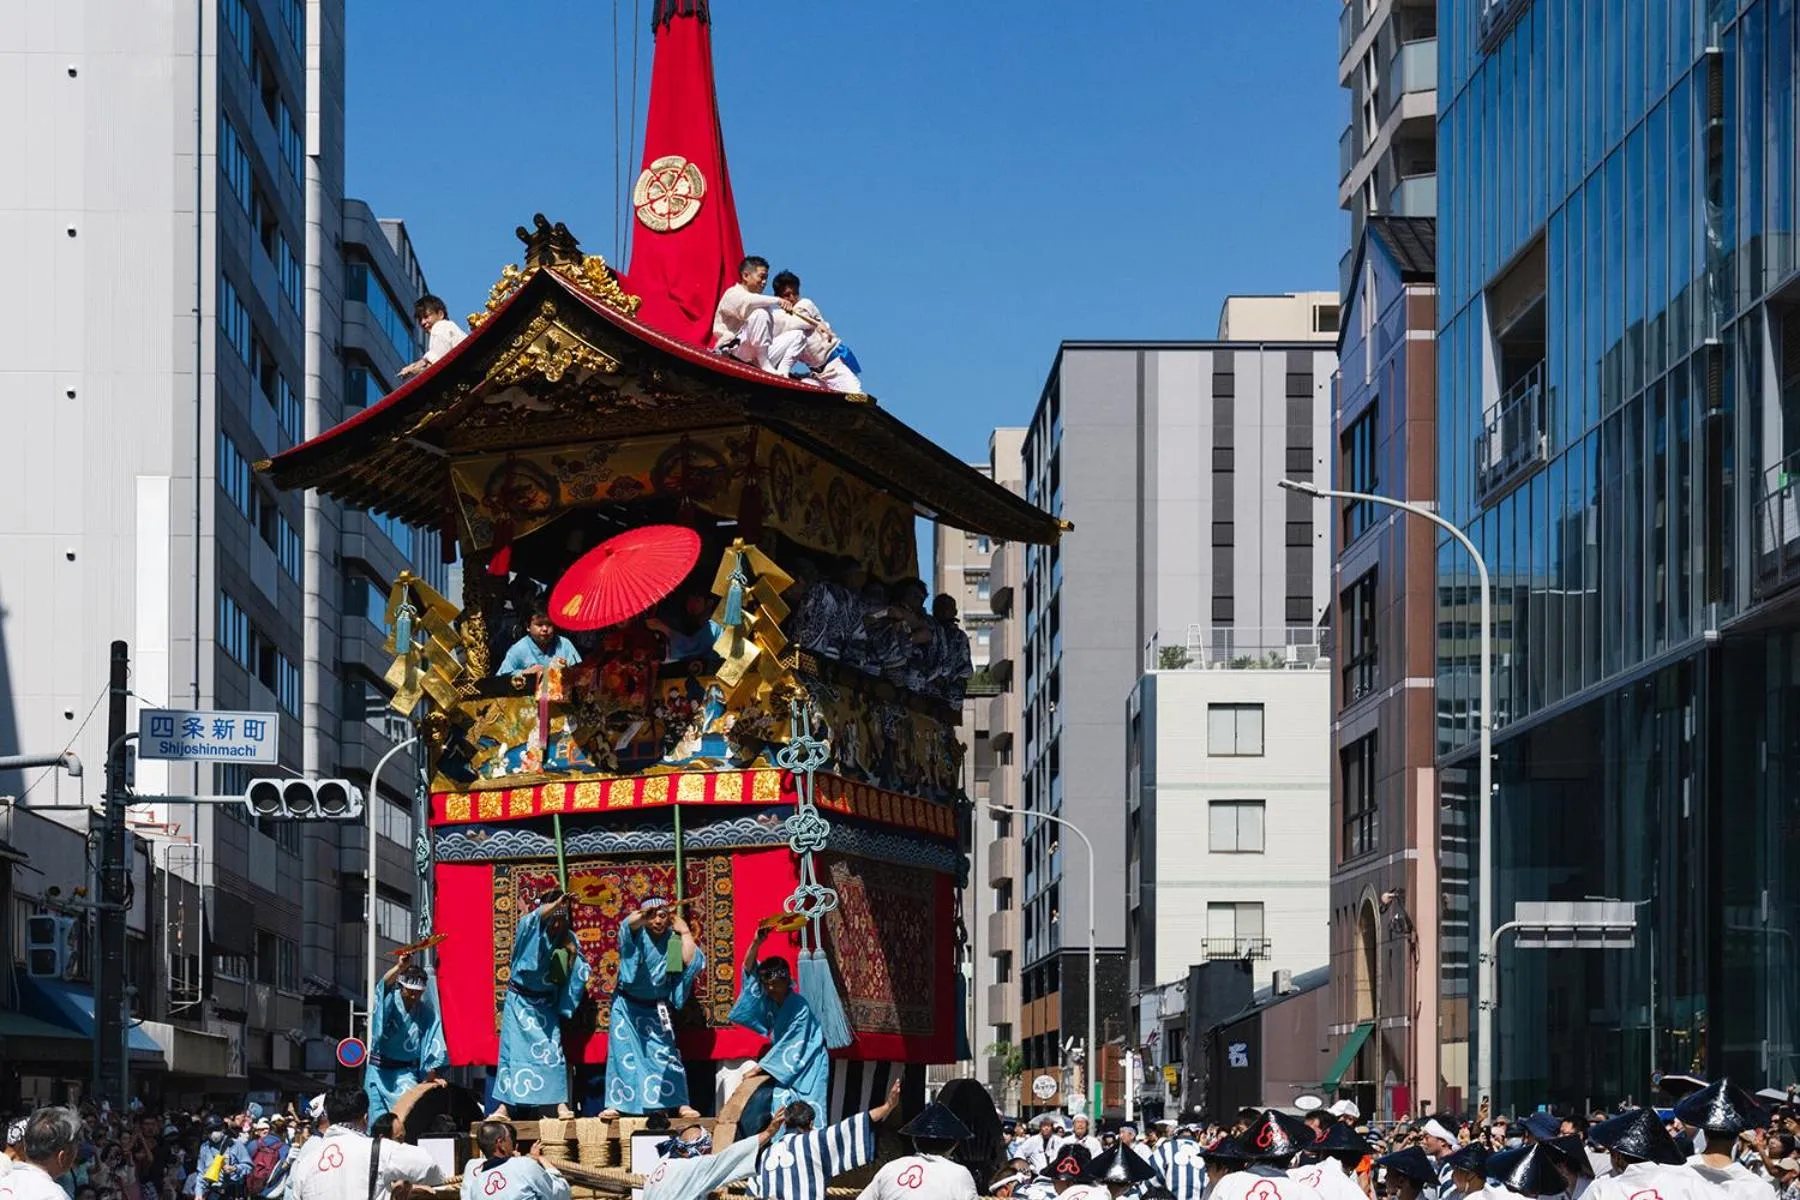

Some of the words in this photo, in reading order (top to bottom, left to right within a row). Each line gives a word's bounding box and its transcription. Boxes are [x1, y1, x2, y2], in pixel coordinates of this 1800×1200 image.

[151, 716, 267, 741] 四条新町
[160, 741, 256, 757] Shijoshinmachi
